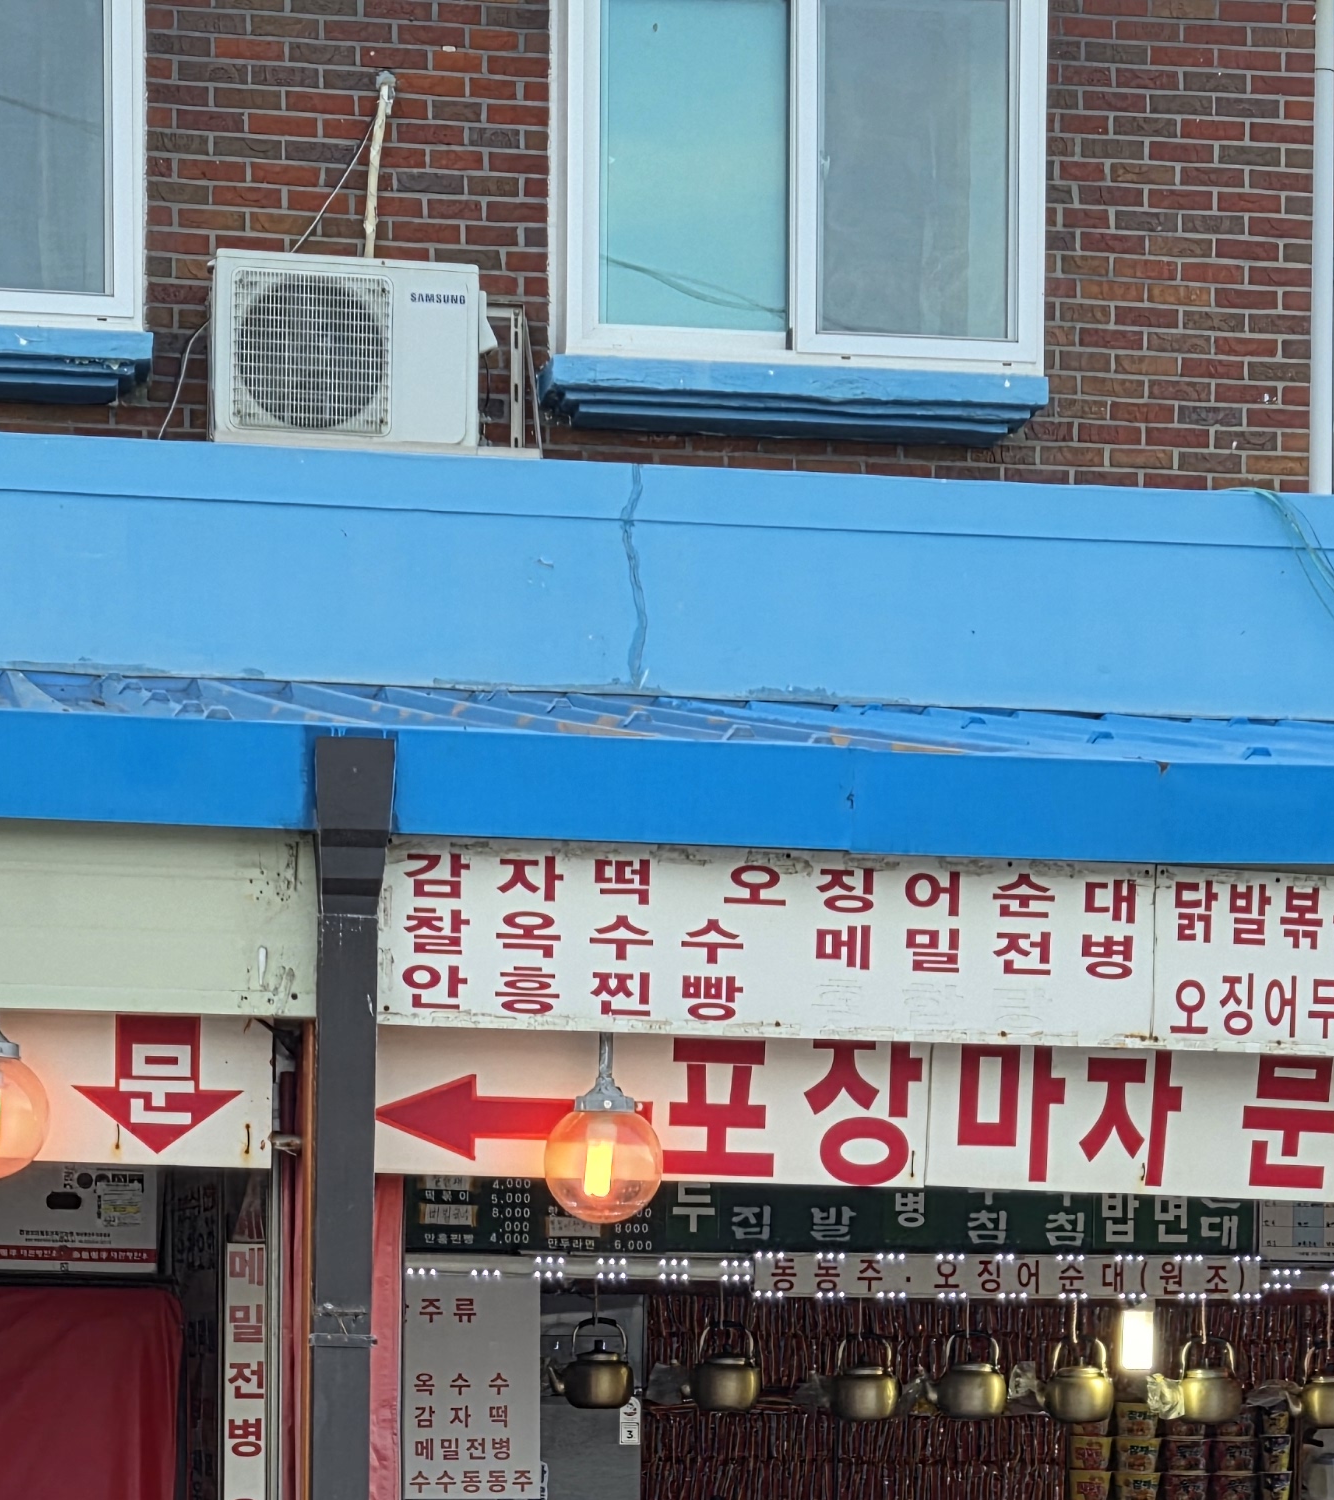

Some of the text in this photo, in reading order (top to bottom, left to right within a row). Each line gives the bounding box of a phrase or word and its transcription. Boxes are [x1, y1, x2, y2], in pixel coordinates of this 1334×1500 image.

[410, 292, 466, 305] SAMSUNG
[403, 852, 1137, 924] 감자떡 오징어순대
[403, 907, 1135, 980] 찰옥수수 메밀전병
[401, 963, 745, 1022] 안흥찐빵
[771, 1257, 884, 1293] 동동주
[404, 1297, 478, 1325] 주류
[227, 1246, 266, 1459] 메밀전병
[413, 1372, 510, 1396] 옥수수
[414, 1404, 510, 1430] 감자떡
[414, 1436, 512, 1462] 메밀전병
[409, 1469, 534, 1494] 수수동동주
